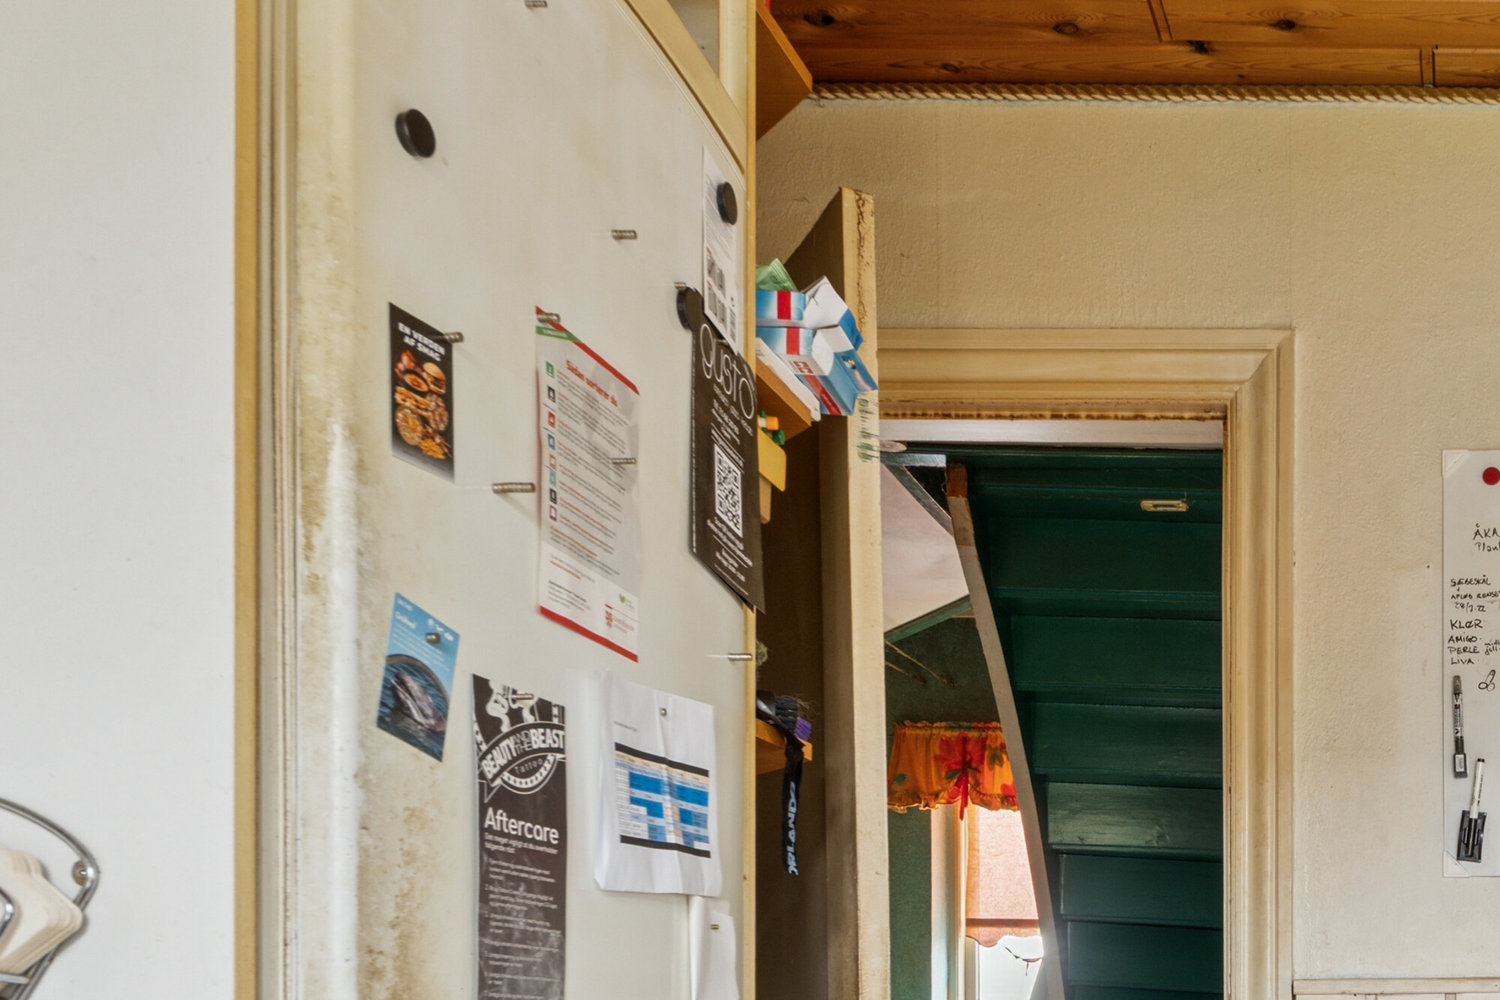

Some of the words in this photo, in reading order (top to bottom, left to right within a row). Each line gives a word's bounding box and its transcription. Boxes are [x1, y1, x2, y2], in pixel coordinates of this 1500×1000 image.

[1448, 646, 1480, 655] PERLE
[482, 736, 518, 779] BEAUTY
[530, 727, 565, 750] BEAST
[514, 758, 545, 775] Tattoo
[484, 806, 560, 845] Aftercare
